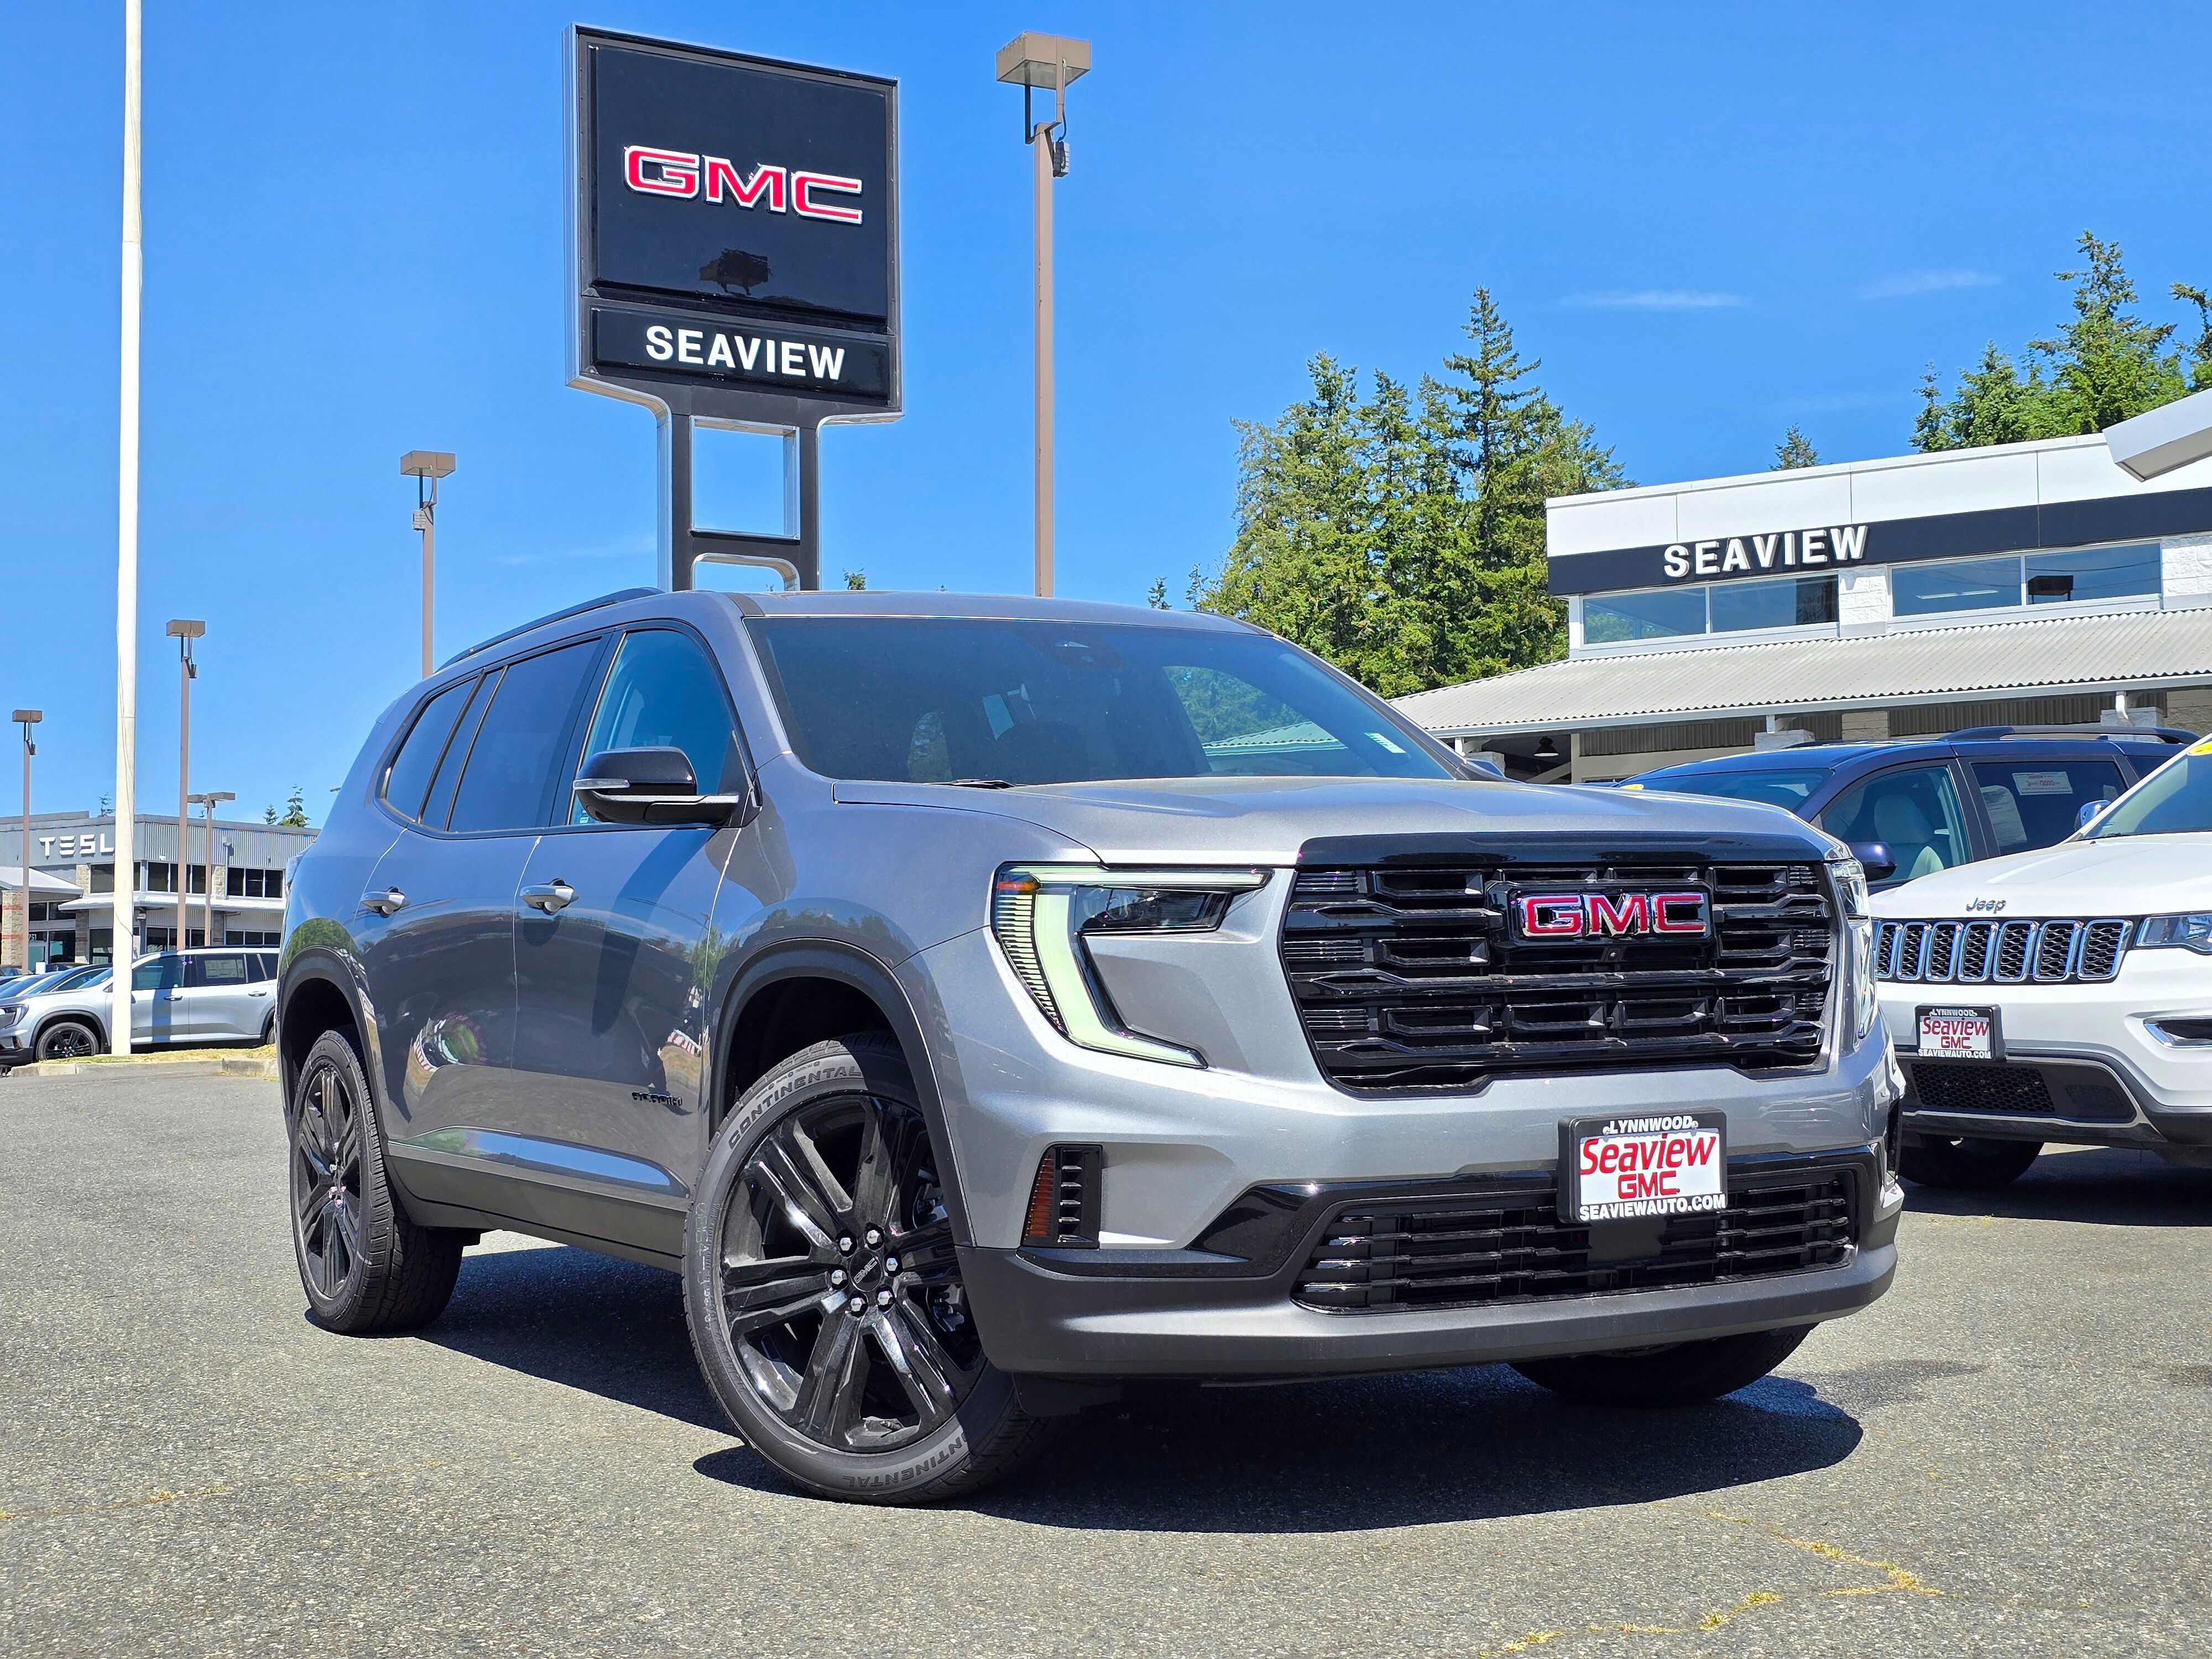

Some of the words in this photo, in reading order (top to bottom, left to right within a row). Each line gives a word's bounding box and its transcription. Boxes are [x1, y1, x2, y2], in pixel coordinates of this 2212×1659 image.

[624, 145, 862, 225] GMC
[646, 325, 845, 380] SEAVIEW
[1664, 525, 1868, 578] SEAVIEW
[39, 833, 115, 857] TESL
[1522, 893, 1706, 936] GMC
[1966, 897, 2006, 914] Jeep
[1922, 1016, 1990, 1036] Seaview
[1918, 1048, 1991, 1059] SEAVIEWAUTO.COM
[1941, 1036, 1972, 1049] GMC
[728, 1066, 862, 1150] CONTINENTAL
[1609, 1115, 1693, 1134] LYNNWOOD
[1580, 1133, 1717, 1175] Seaview
[1618, 1170, 1679, 1199] GMC
[1579, 1194, 1726, 1221] SEAVIEWAUTO.COM
[854, 1258, 878, 1284] GMC
